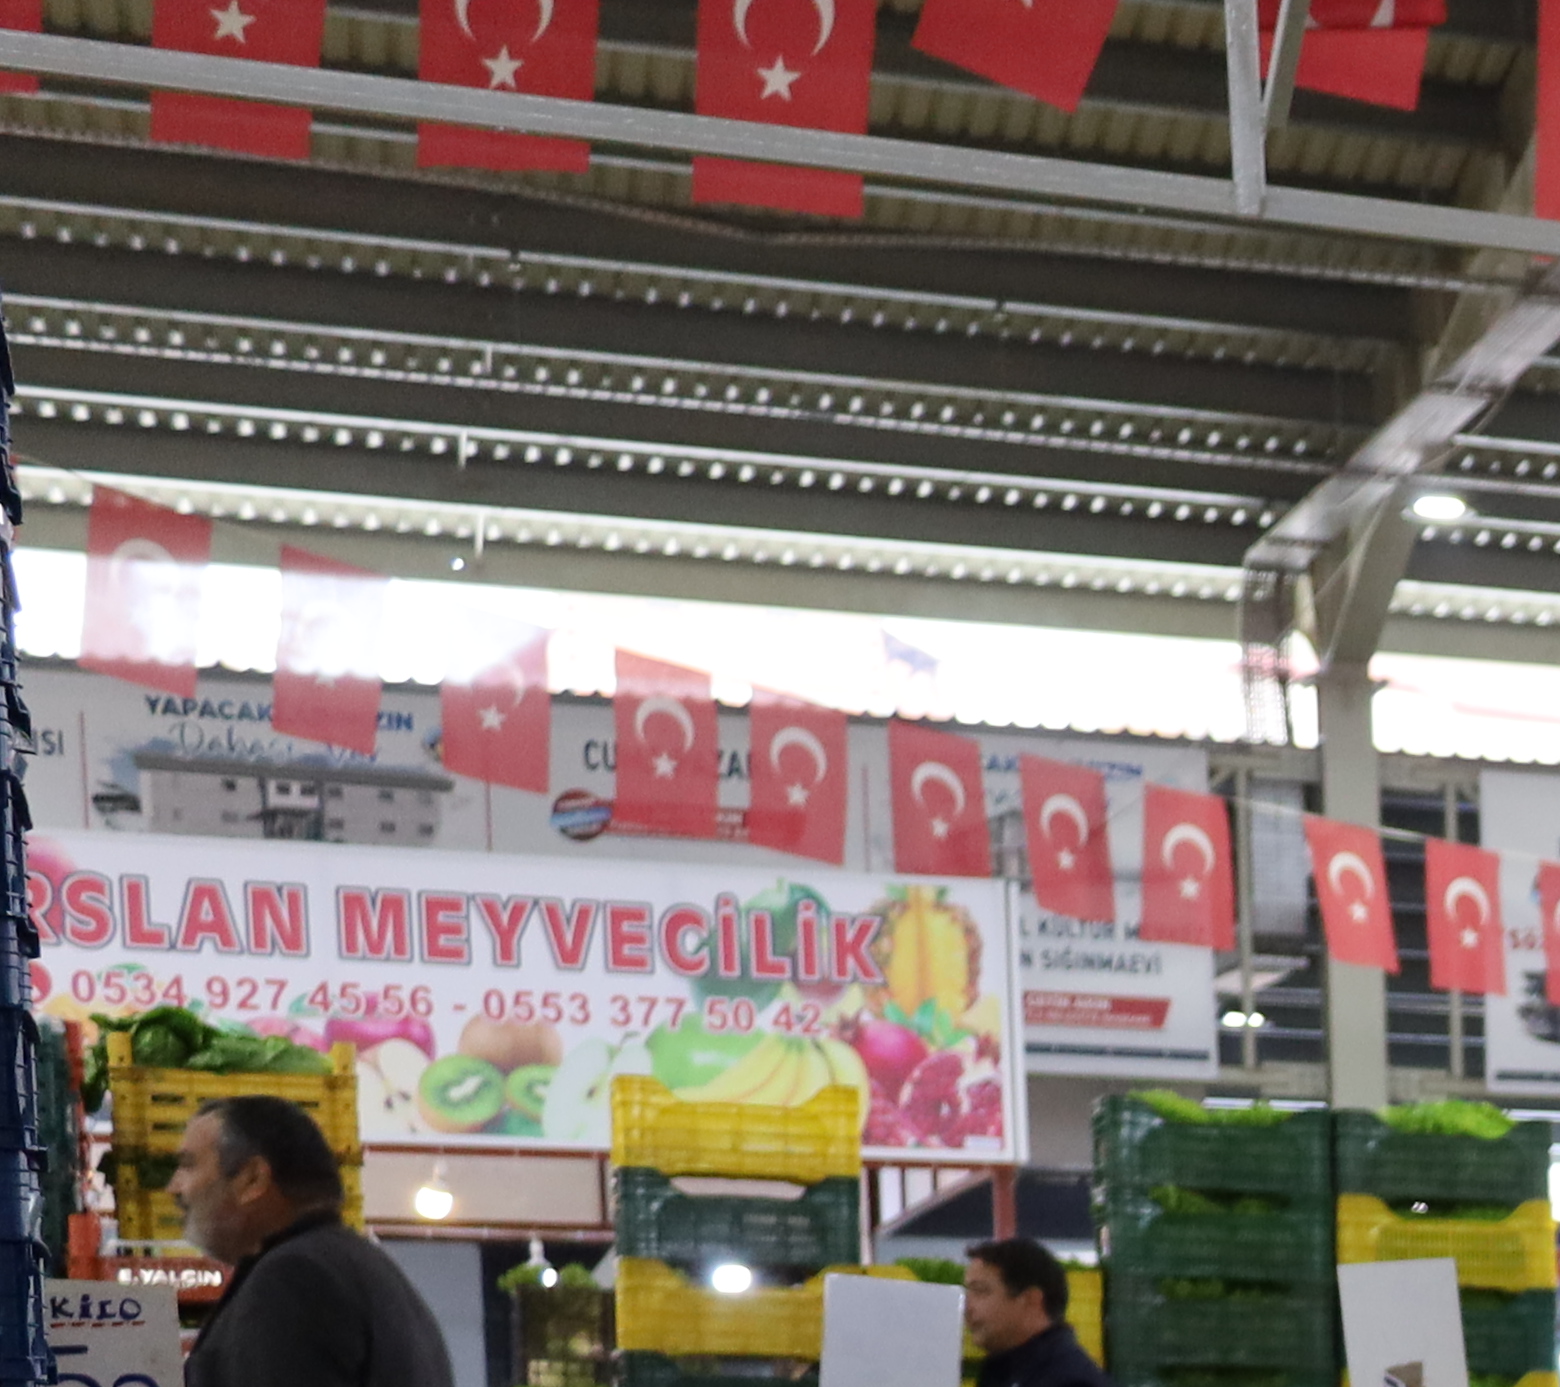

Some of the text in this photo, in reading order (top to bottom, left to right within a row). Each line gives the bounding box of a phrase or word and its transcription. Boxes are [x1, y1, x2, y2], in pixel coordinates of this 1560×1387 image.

[336, 884, 886, 986] MEYVECİLİK
[71, 969, 189, 1009] 0534
[206, 976, 290, 1014] 927
[308, 980, 367, 1016] 45
[382, 983, 434, 1019] 56
[483, 987, 591, 1027] 0553
[610, 993, 687, 1030] 377
[706, 997, 756, 1033] 50
[773, 1001, 823, 1036] 42
